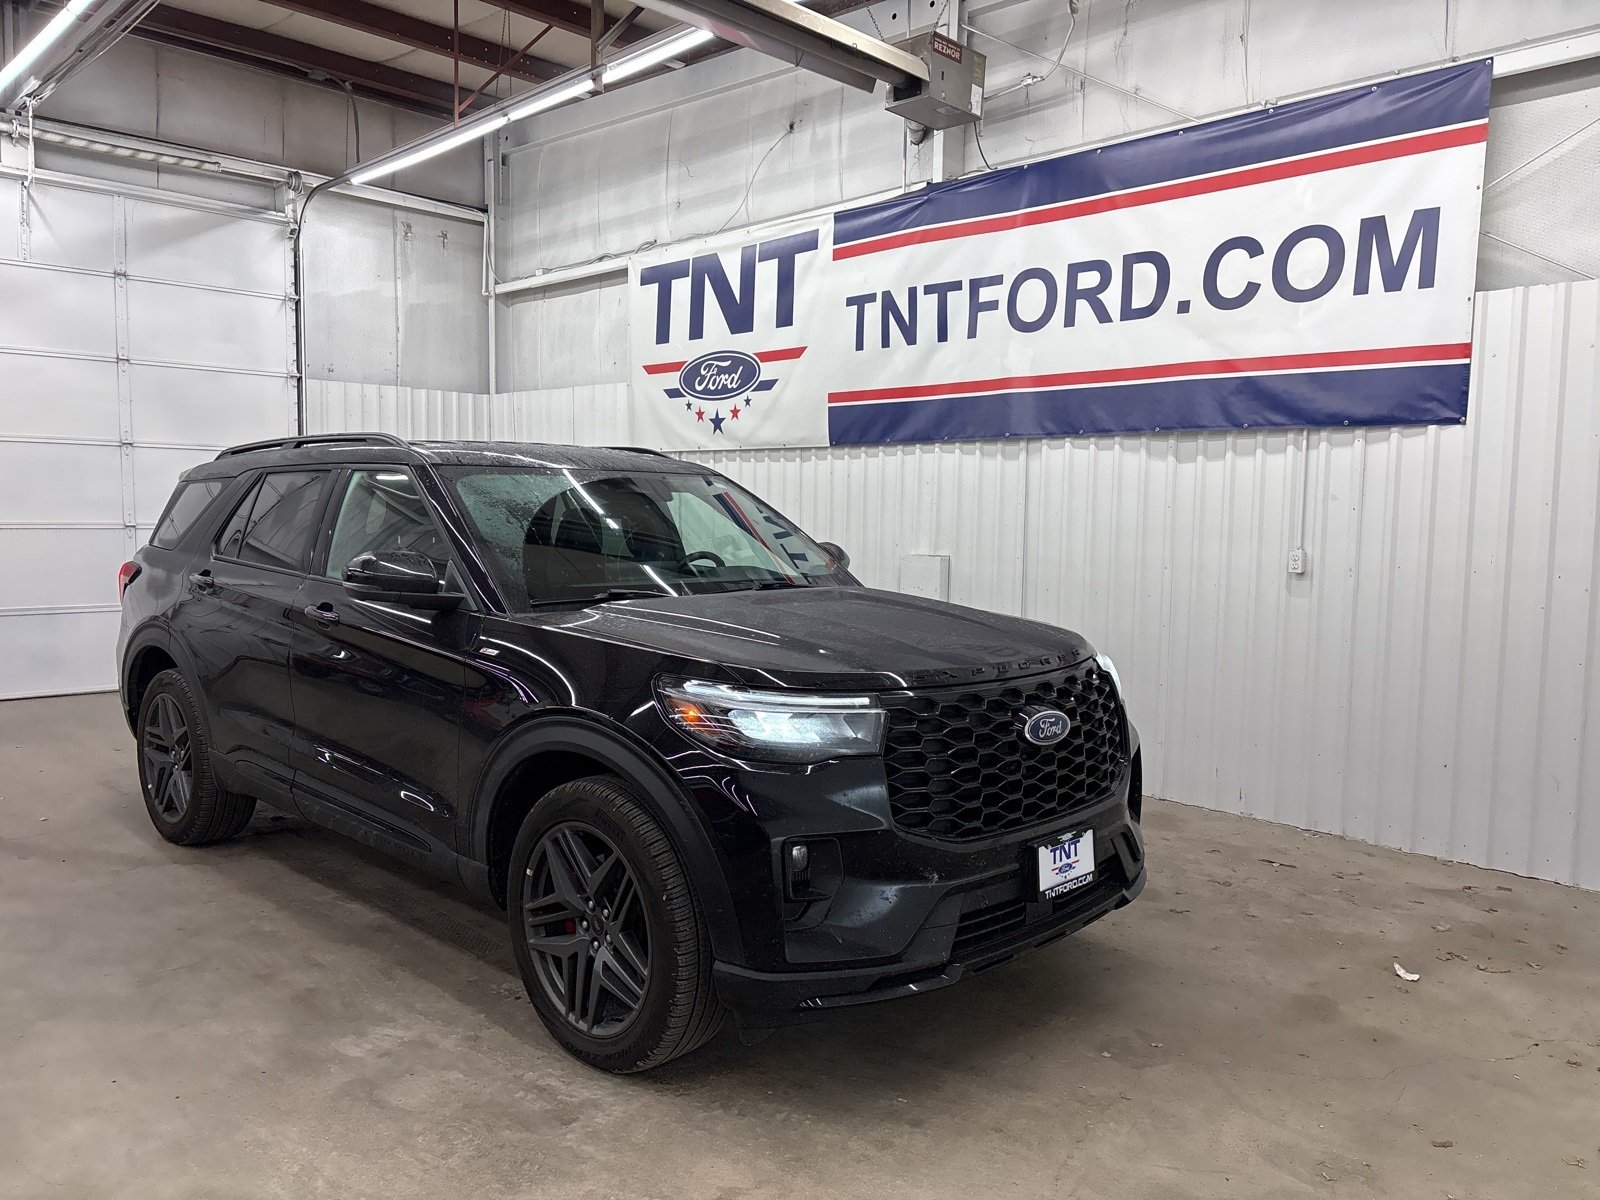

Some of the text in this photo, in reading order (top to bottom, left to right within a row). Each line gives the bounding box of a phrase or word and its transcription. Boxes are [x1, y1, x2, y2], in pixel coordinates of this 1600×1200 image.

[934, 41, 961, 60] REZNOR
[640, 228, 819, 345] TNT
[845, 206, 1441, 352] TNTFORD.COM
[694, 360, 744, 391] Ford
[1038, 717, 1062, 738] Ford
[1049, 839, 1081, 865] TNT
[1045, 873, 1093, 899] TNTFORD.COM
